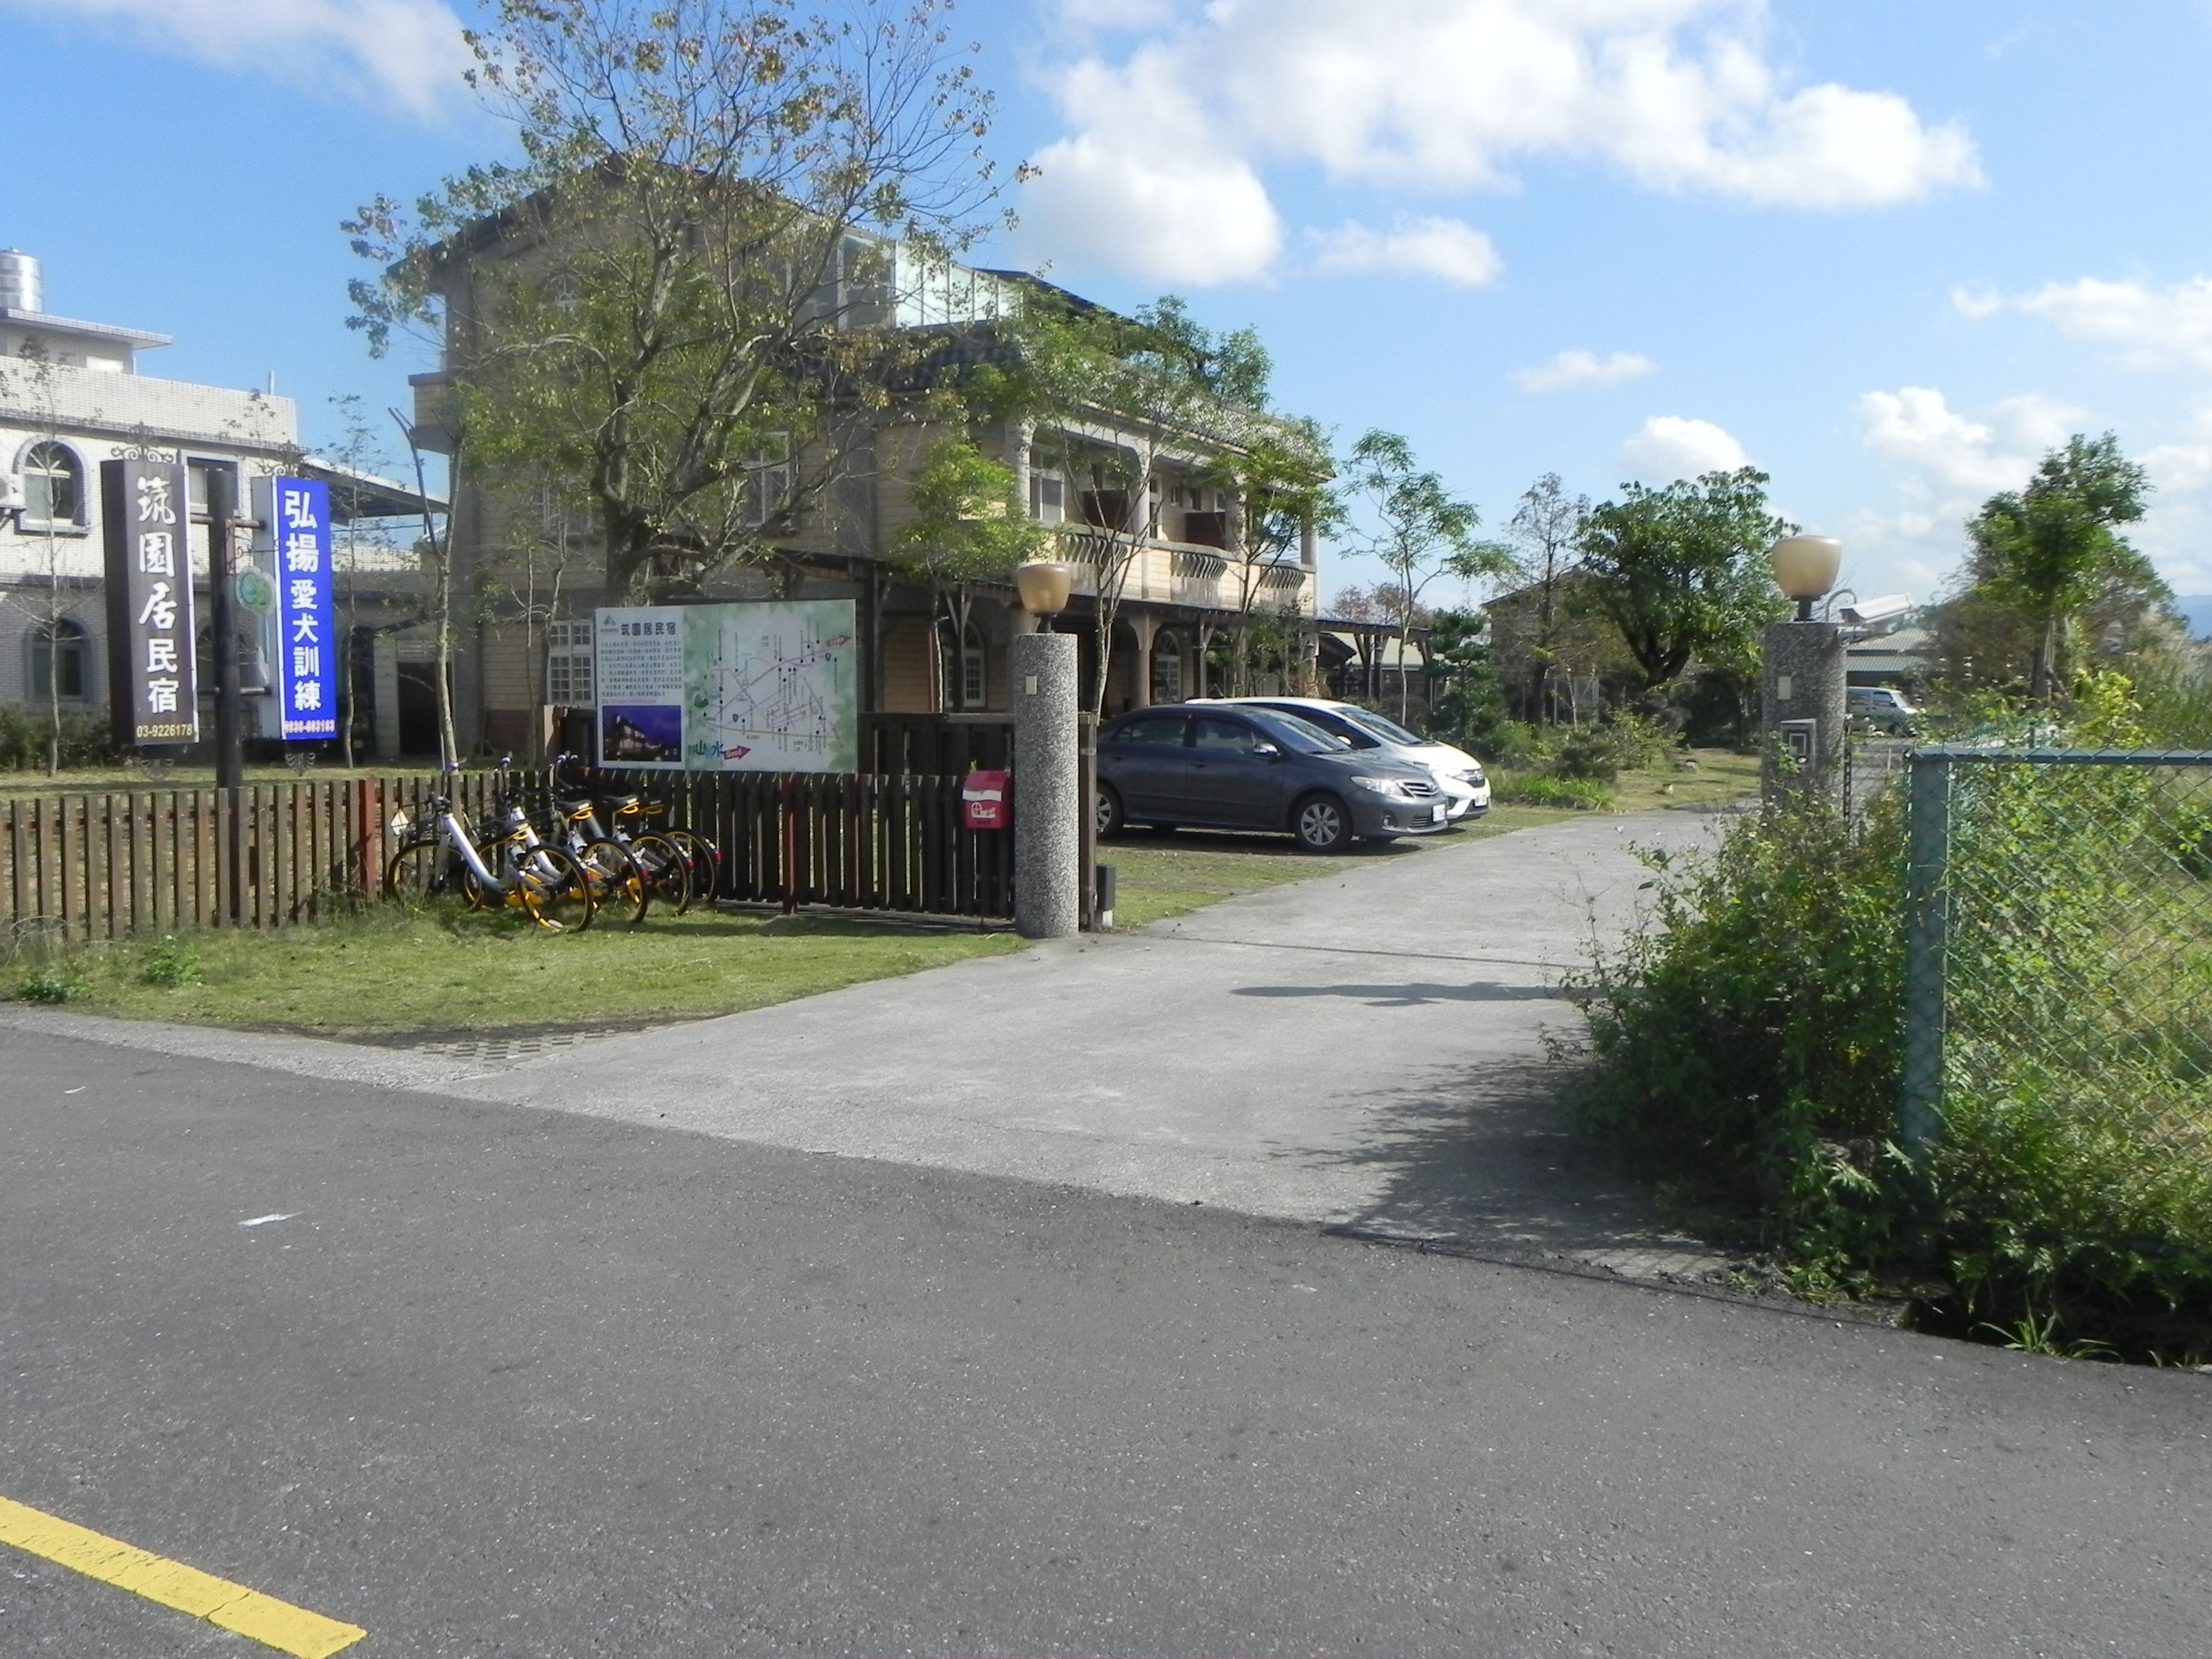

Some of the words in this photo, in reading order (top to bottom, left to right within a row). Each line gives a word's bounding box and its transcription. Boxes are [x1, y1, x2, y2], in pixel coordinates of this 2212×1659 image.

[137, 475, 179, 714] 筑園居民宿
[284, 490, 321, 712] 弘揚愛犬訓練
[136, 724, 193, 737] 03-9226178
